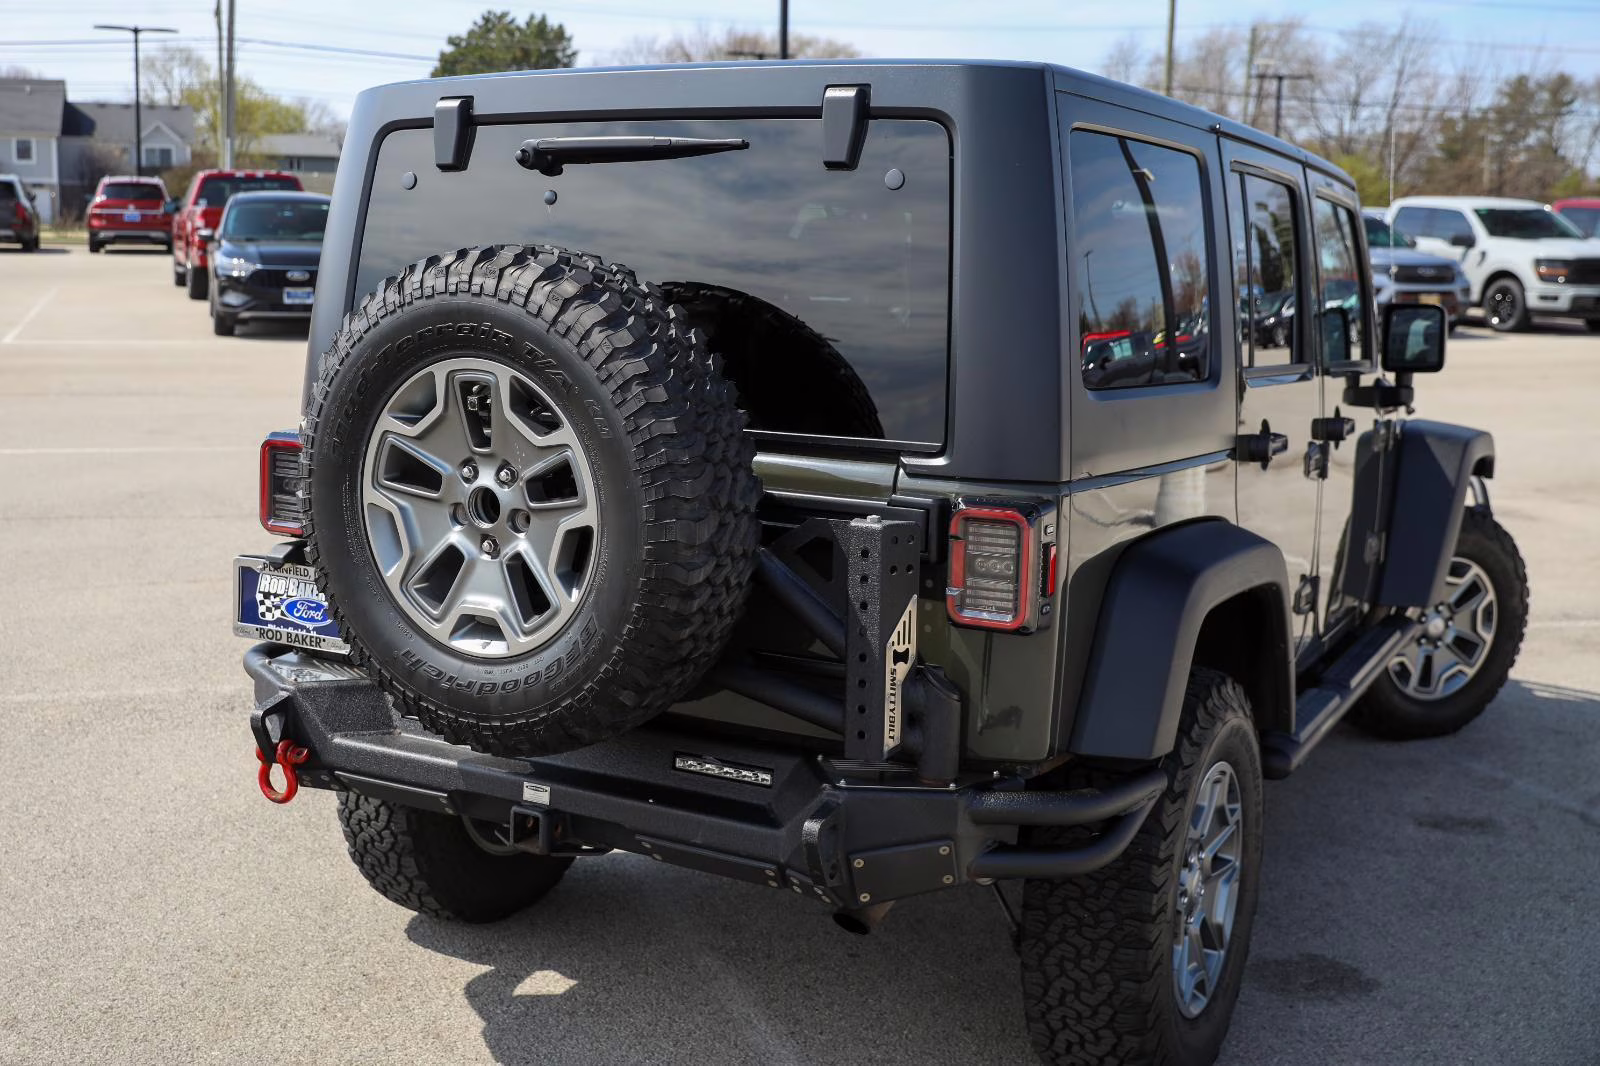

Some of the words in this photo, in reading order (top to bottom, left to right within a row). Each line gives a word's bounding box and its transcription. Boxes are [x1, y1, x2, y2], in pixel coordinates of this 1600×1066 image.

[259, 573, 287, 595] ROD
[294, 601, 323, 619] Ford
[259, 628, 283, 642] ROD
[286, 632, 323, 648] BAKER
[399, 613, 599, 697] BFGoodrich
[889, 667, 897, 741] SMITTYBILT
